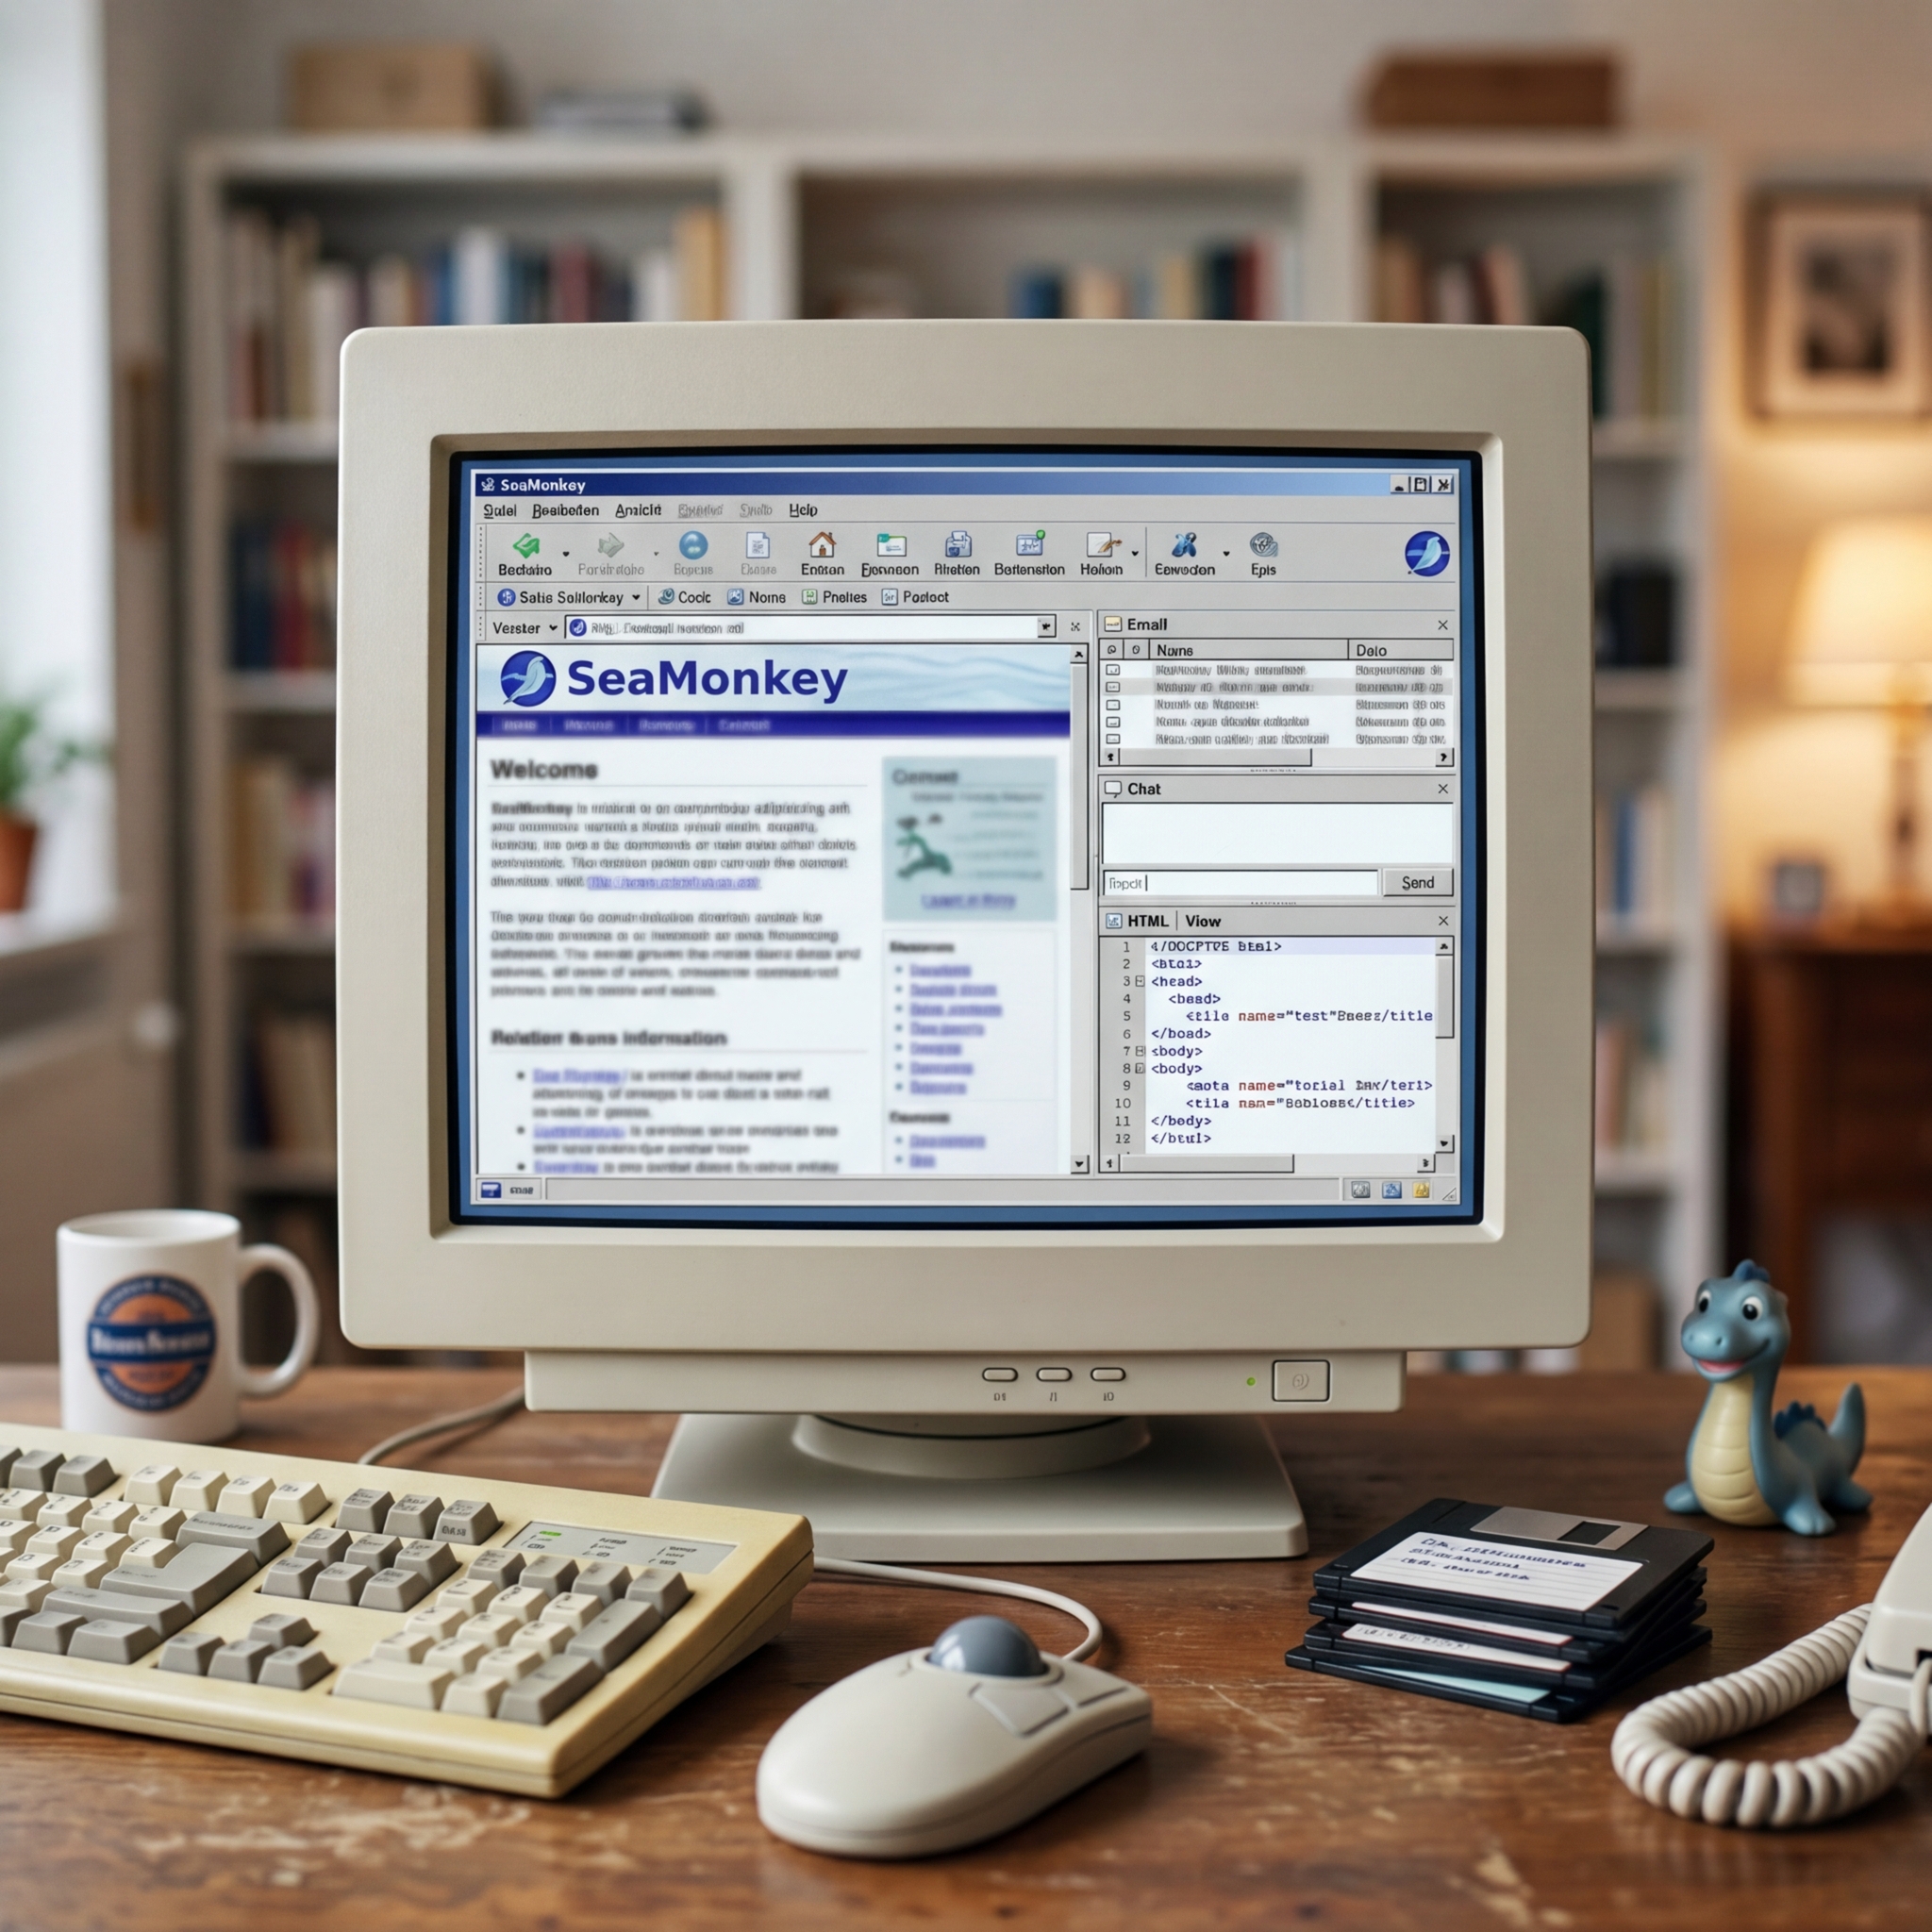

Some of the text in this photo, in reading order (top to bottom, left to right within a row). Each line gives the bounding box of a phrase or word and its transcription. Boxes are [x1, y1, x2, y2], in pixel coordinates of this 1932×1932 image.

[569, 659, 848, 704] SeaMonkey
[1128, 783, 1161, 795] Chat
[1402, 876, 1434, 891] Send
[1128, 915, 1169, 926] HTML
[1124, 941, 1129, 953] 1
[1124, 958, 1130, 969] 2
[1124, 994, 1130, 1004] 4
[1124, 1011, 1130, 1021] 5
[1124, 1029, 1131, 1039] 6
[1124, 1046, 1130, 1056] 7
[1123, 1063, 1202, 1075] 8 <body>
[1124, 1080, 1130, 1091] 9
[1116, 1098, 1131, 1108] 10
[1116, 1116, 1130, 1126] 11
[1116, 1134, 1130, 1143] 12
